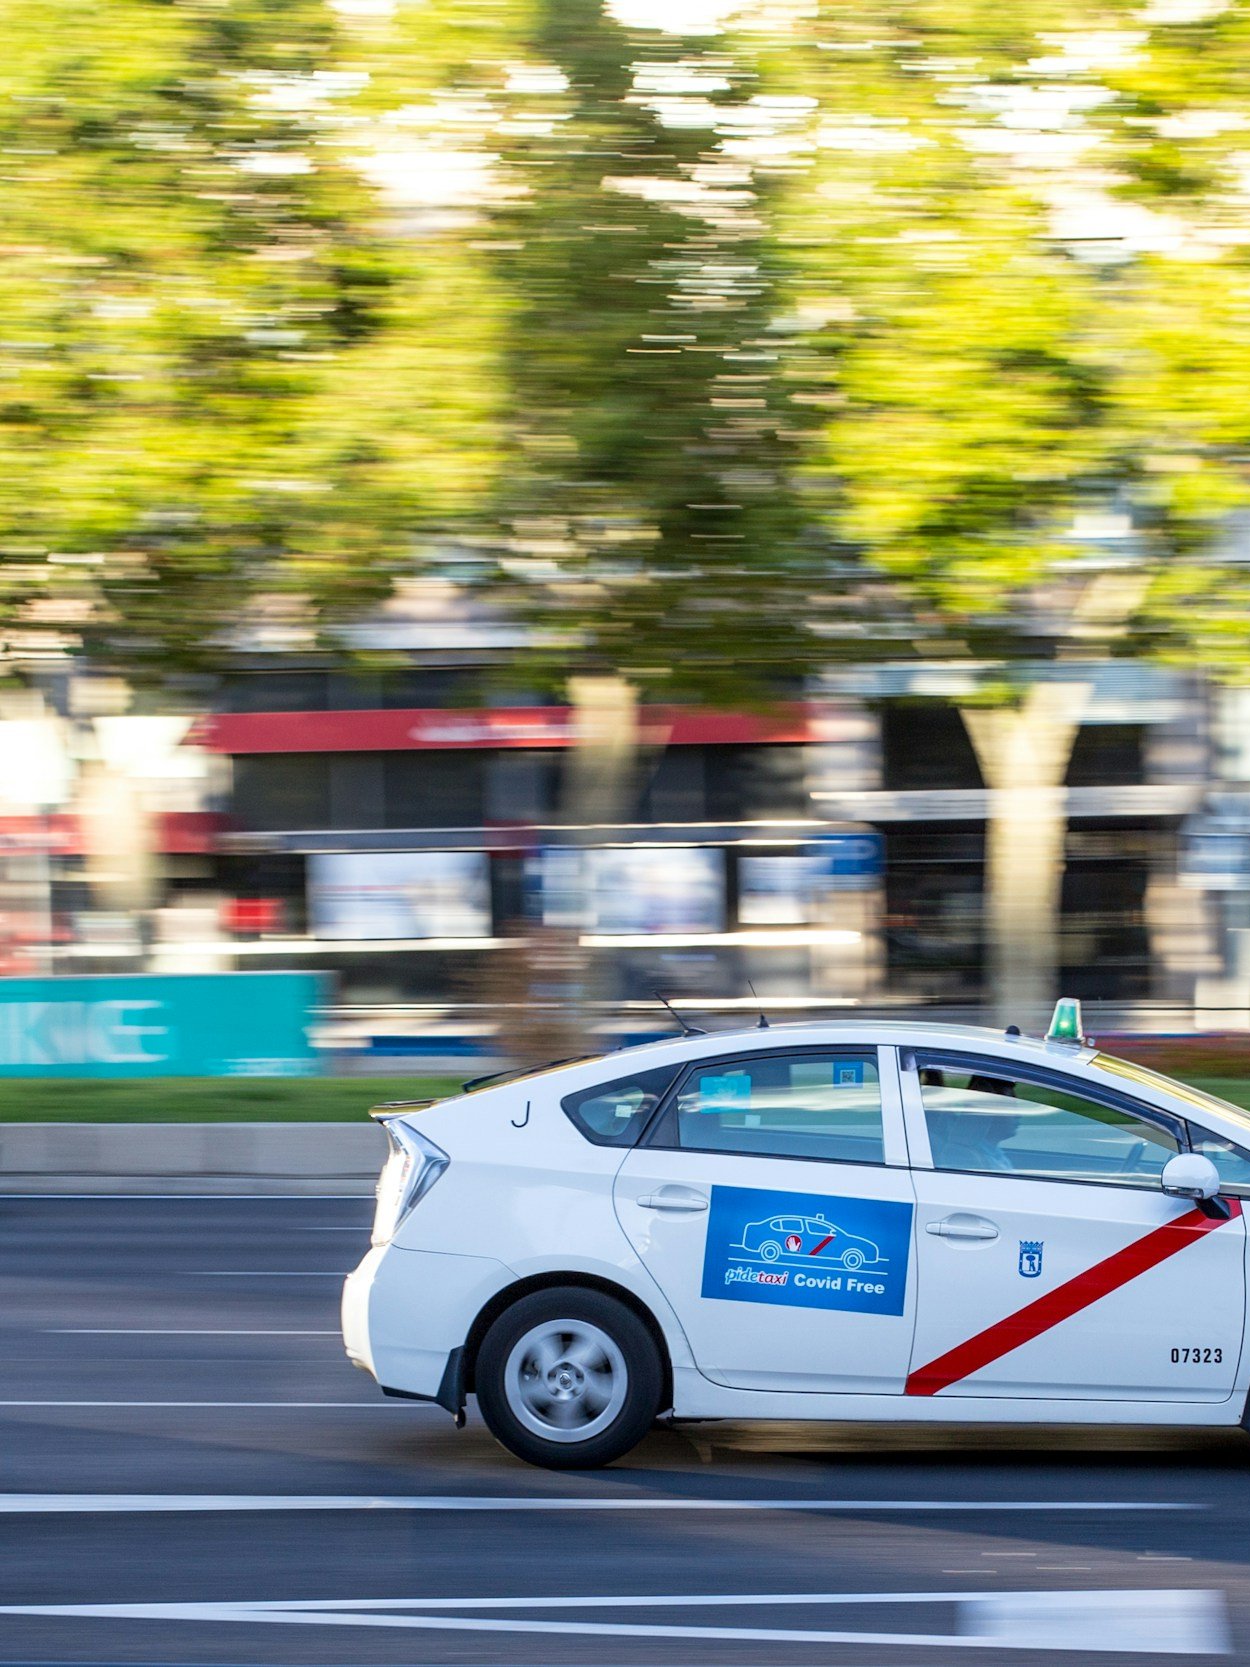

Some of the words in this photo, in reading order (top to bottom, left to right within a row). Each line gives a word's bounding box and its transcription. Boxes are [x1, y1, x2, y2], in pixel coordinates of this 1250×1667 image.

[511, 1100, 531, 1128] J
[725, 1266, 789, 1285] pidetaxi
[794, 1273, 841, 1290] Covid
[847, 1278, 885, 1294] Free
[1171, 1348, 1223, 1364] 07323
